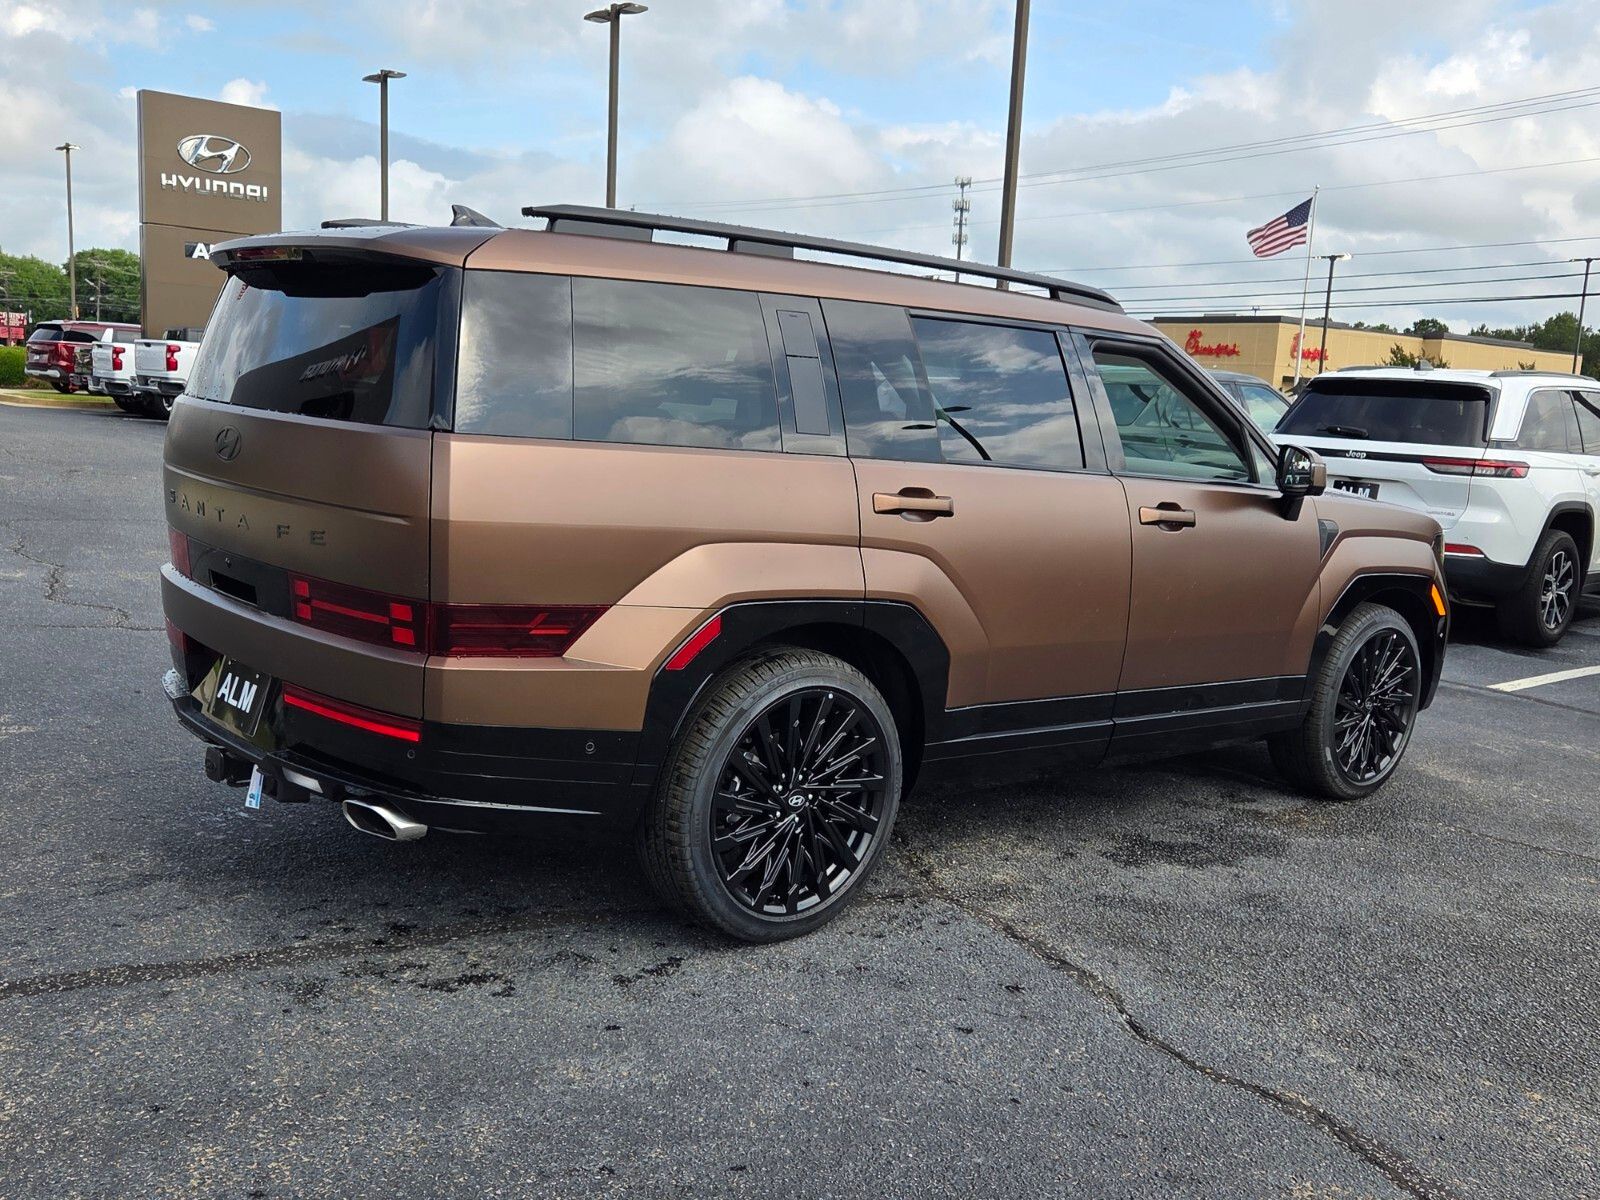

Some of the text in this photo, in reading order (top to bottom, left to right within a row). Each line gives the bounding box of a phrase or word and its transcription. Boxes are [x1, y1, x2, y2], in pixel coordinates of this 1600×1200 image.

[161, 173, 268, 201] HYUNDAI
[1345, 449, 1367, 459] Jeep
[169, 488, 327, 546] SANTA FE
[217, 672, 258, 714] ALM
